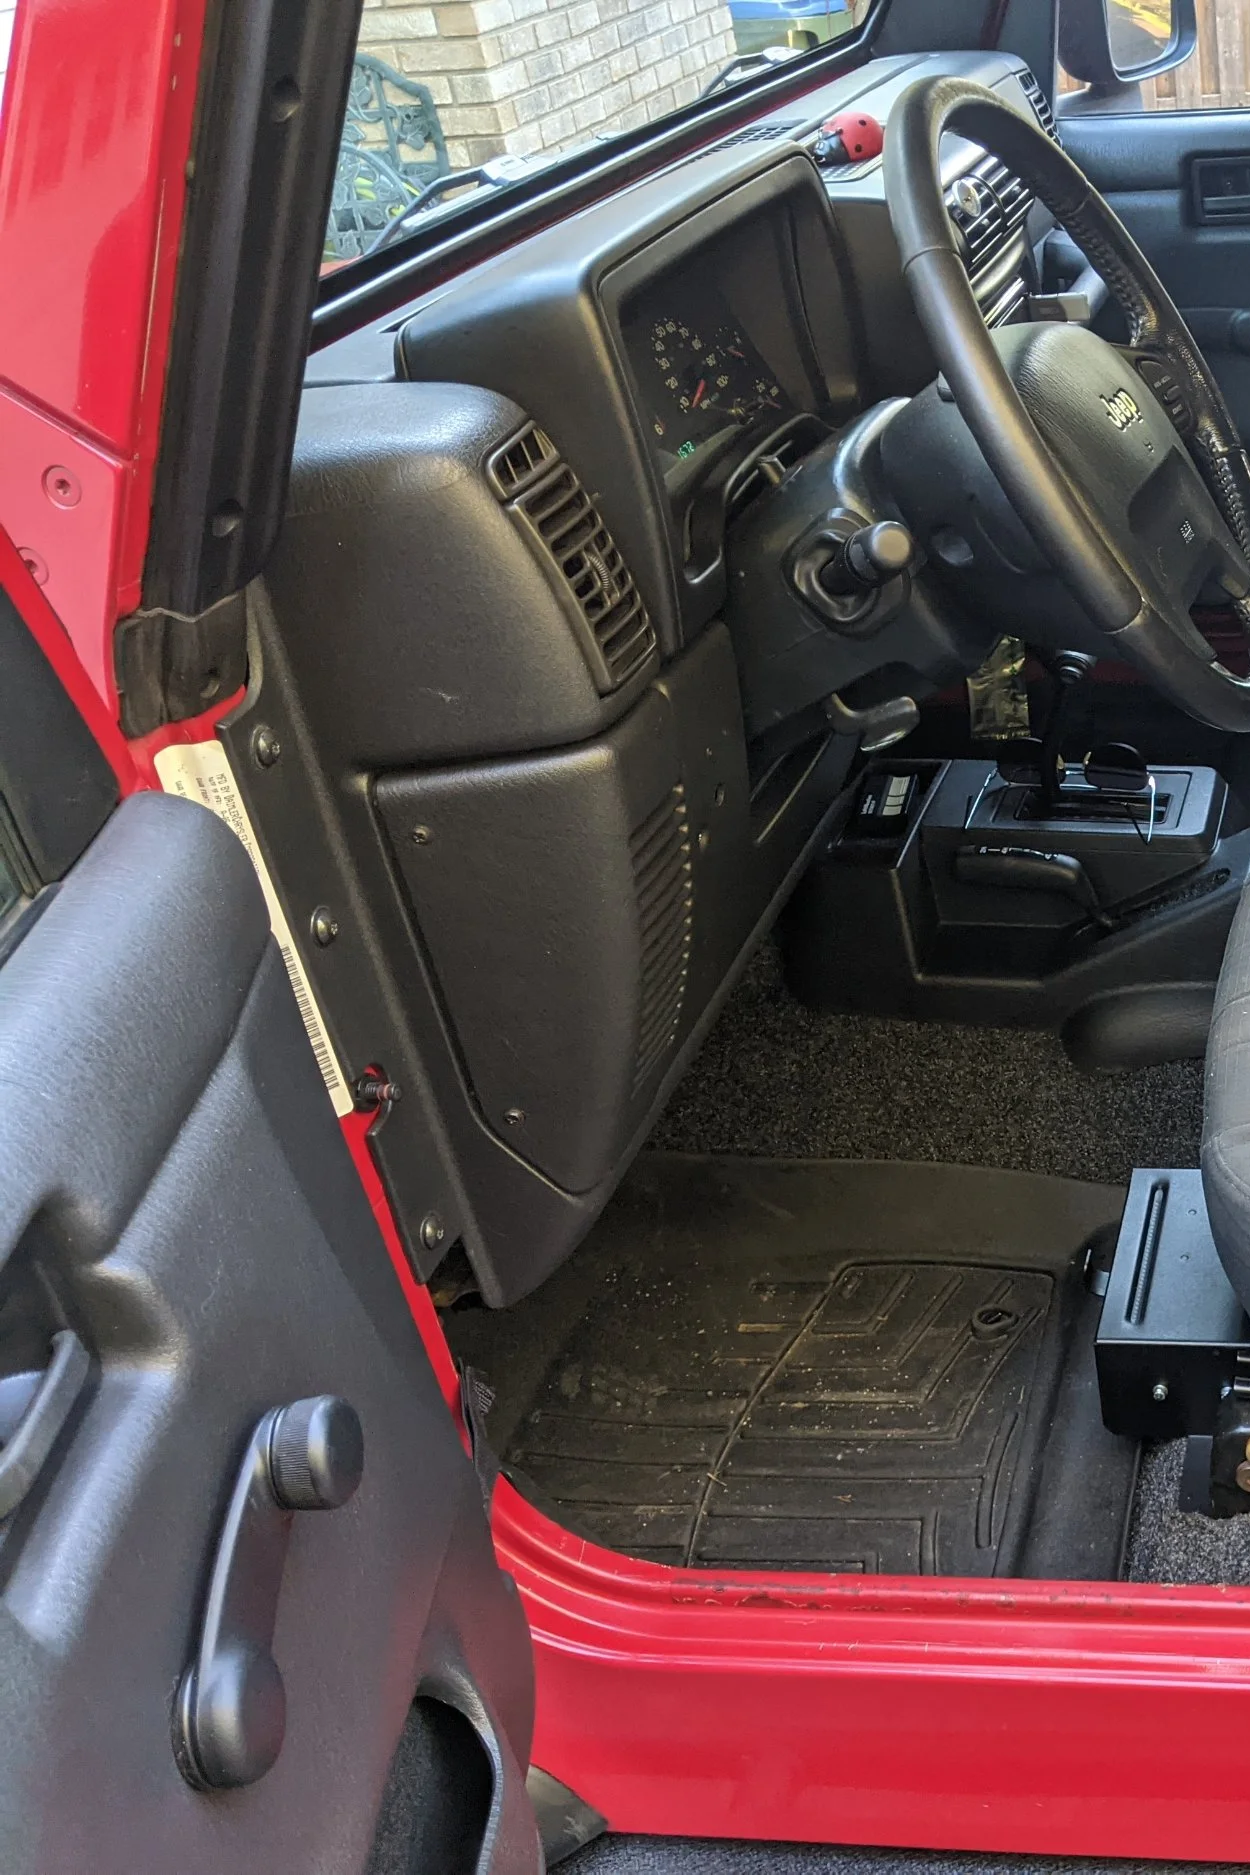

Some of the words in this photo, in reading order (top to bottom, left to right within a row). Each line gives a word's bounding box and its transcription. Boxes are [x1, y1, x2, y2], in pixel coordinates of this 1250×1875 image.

[655, 326, 666, 338] 50
[678, 326, 689, 339] 70
[654, 340, 665, 352] 40
[658, 357, 670, 370] 30
[667, 376, 679, 389] 20
[1099, 388, 1141, 429] Jeep
[654, 423, 664, 435] 6
